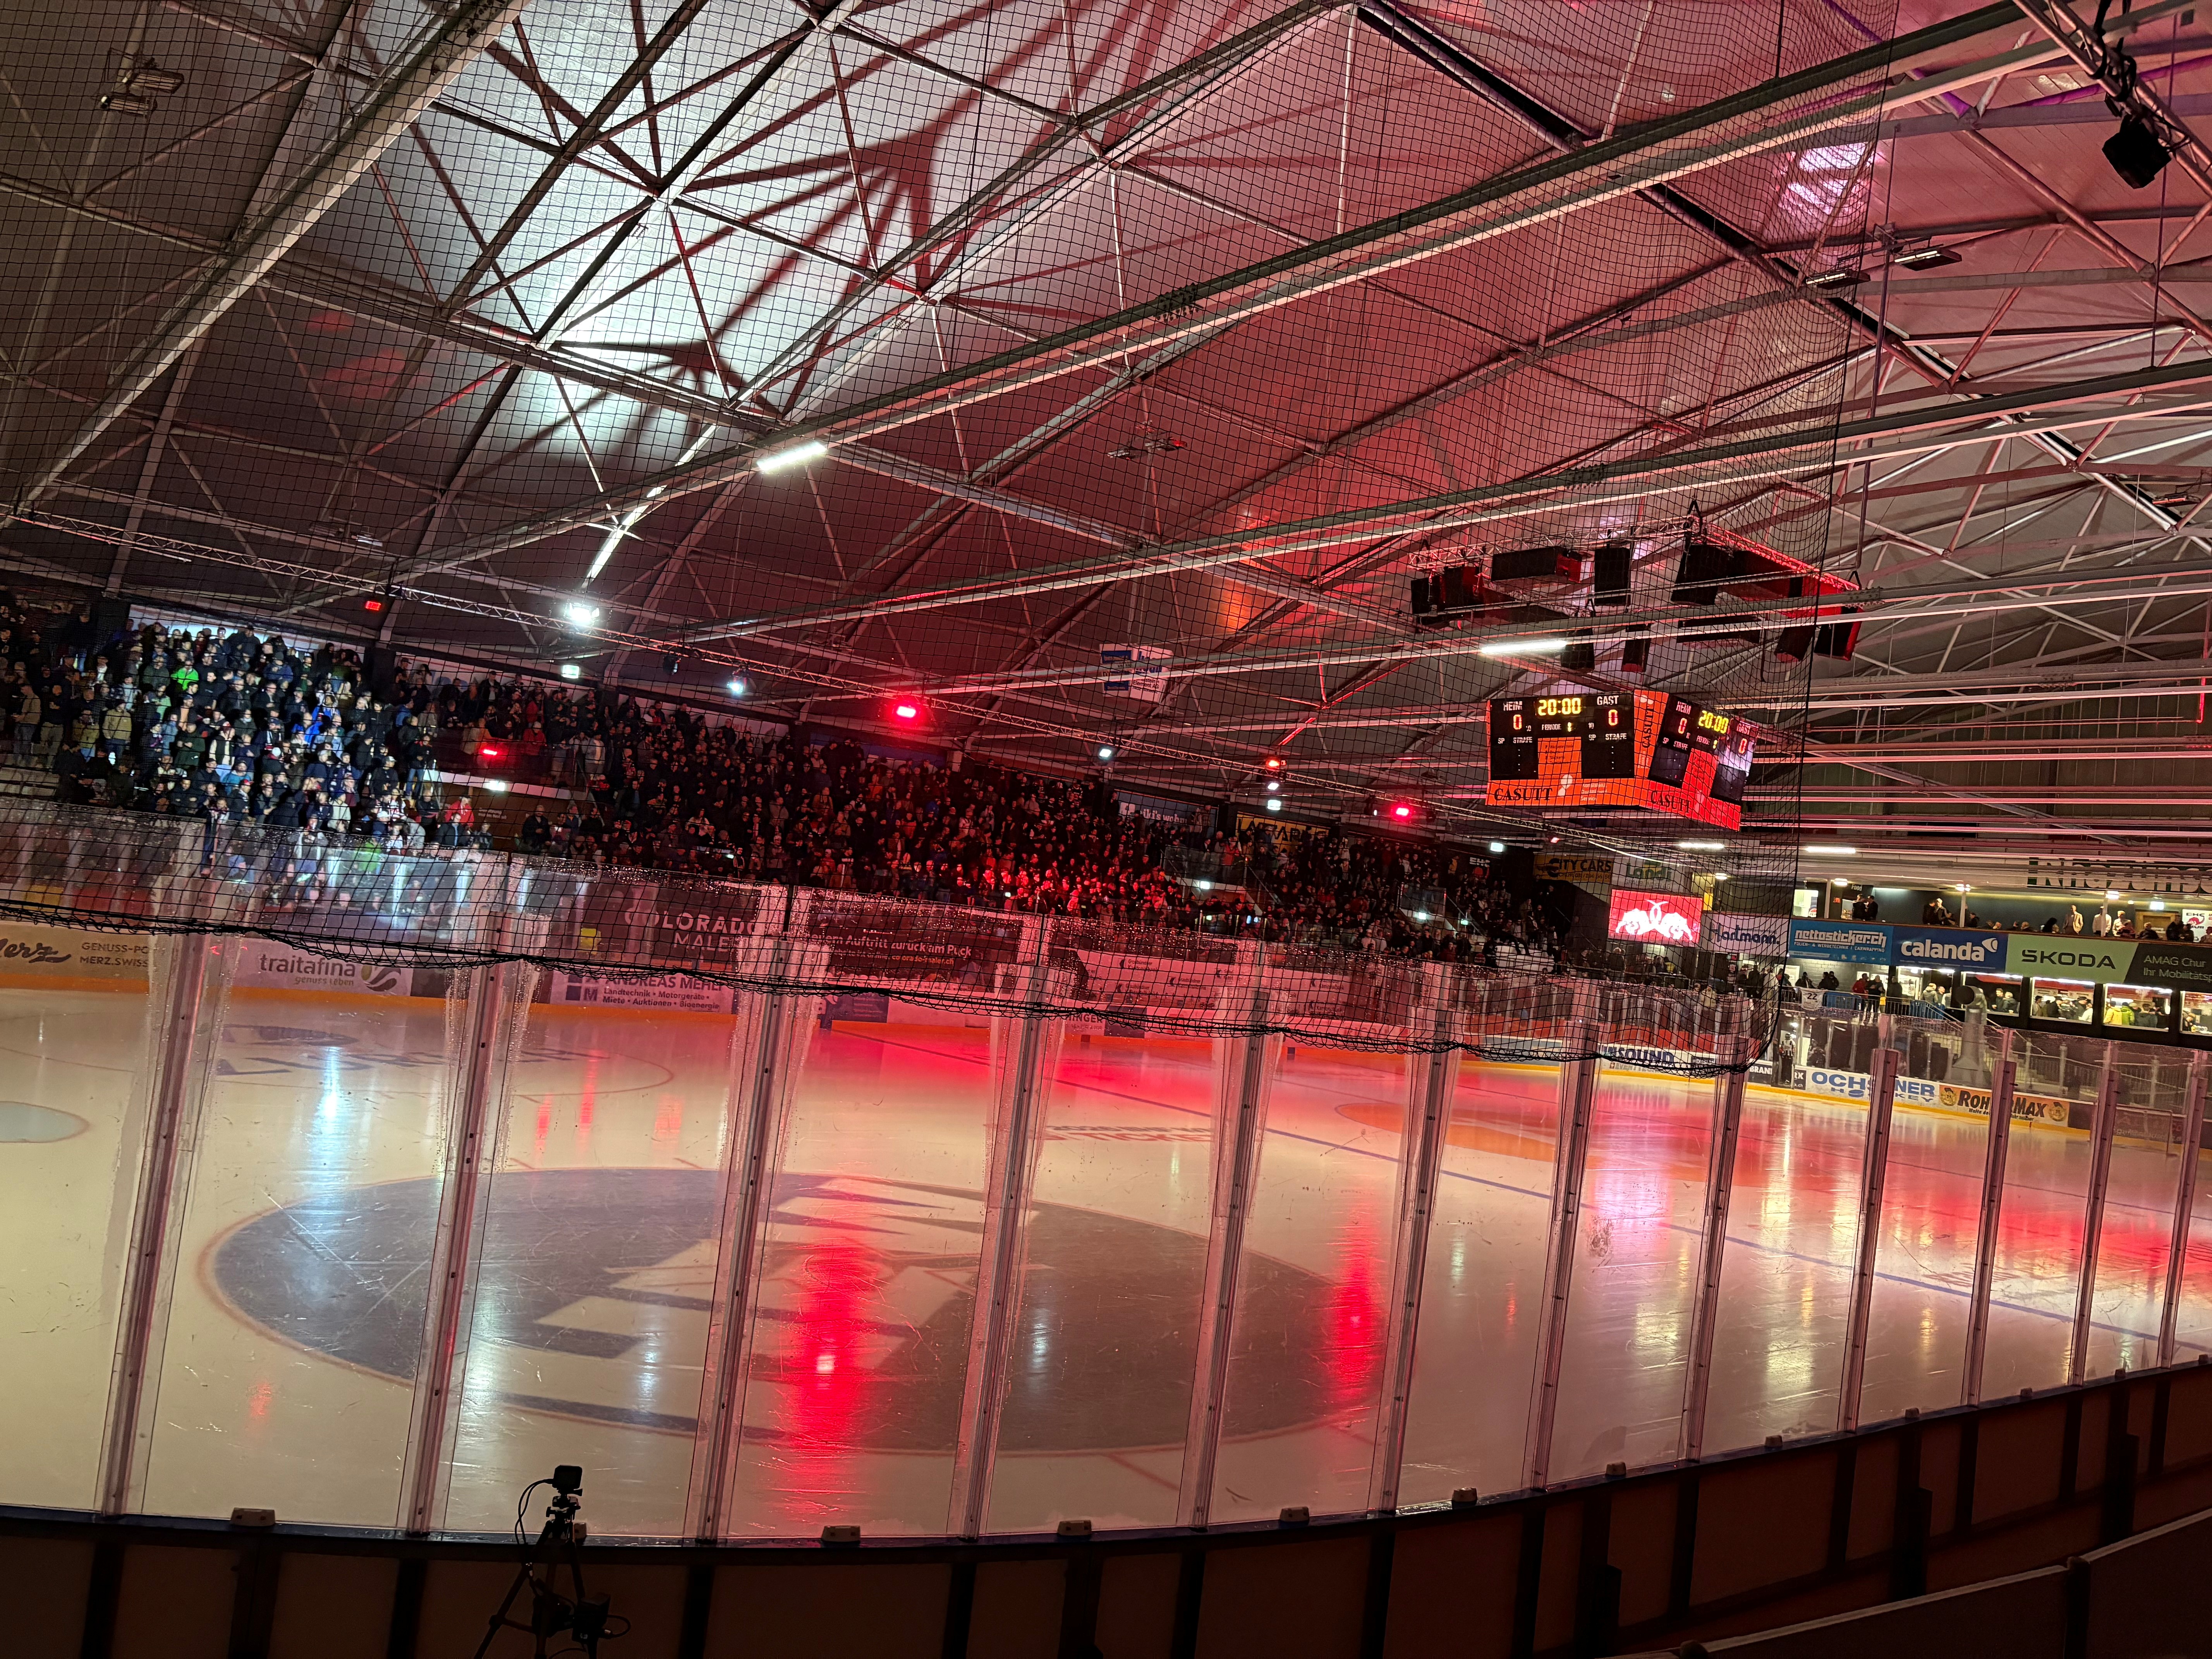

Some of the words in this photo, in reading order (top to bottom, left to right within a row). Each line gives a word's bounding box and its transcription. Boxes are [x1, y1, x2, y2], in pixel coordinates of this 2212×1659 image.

[1503, 701, 1523, 711] HEIM
[1538, 697, 1582, 716] 20:00
[1597, 695, 1619, 705] GAST
[1513, 714, 1522, 730] 0
[1608, 709, 1618, 726] 0
[1676, 701, 1692, 715] HEIM
[1698, 710, 1729, 734] 20:00
[1678, 718, 1687, 734] 0
[1736, 723, 1752, 735] GAST
[1673, 740, 1688, 751] STRAFE
[1738, 738, 1747, 754] 0
[1494, 788, 1553, 801] CASUTT
[1650, 790, 1692, 814] CASUTT
[1549, 858, 1578, 878] CITY
[1580, 859, 1612, 872] CARS
[1627, 862, 1672, 881] Landi
[845, 935, 888, 948] Auftritt
[947, 945, 972, 958] Puck
[1795, 929, 1887, 948] nettosticker.ch
[0, 938, 71, 963] erz
[1901, 939, 1985, 962] calanda
[80, 956, 149, 967] MERZ.SWISS
[260, 954, 356, 977] traitafina
[2143, 955, 2179, 966] AMAG
[2181, 957, 2207, 968] Chur
[295, 976, 327, 985] genuss
[2143, 967, 2156, 976] Ihr
[603, 988, 651, 997] Landtechnik
[658, 991, 705, 1002] Motorgeräte
[603, 996, 625, 1005] Miete
[632, 999, 672, 1007] Auktionen
[1812, 1071, 1936, 1097] OCHNER
